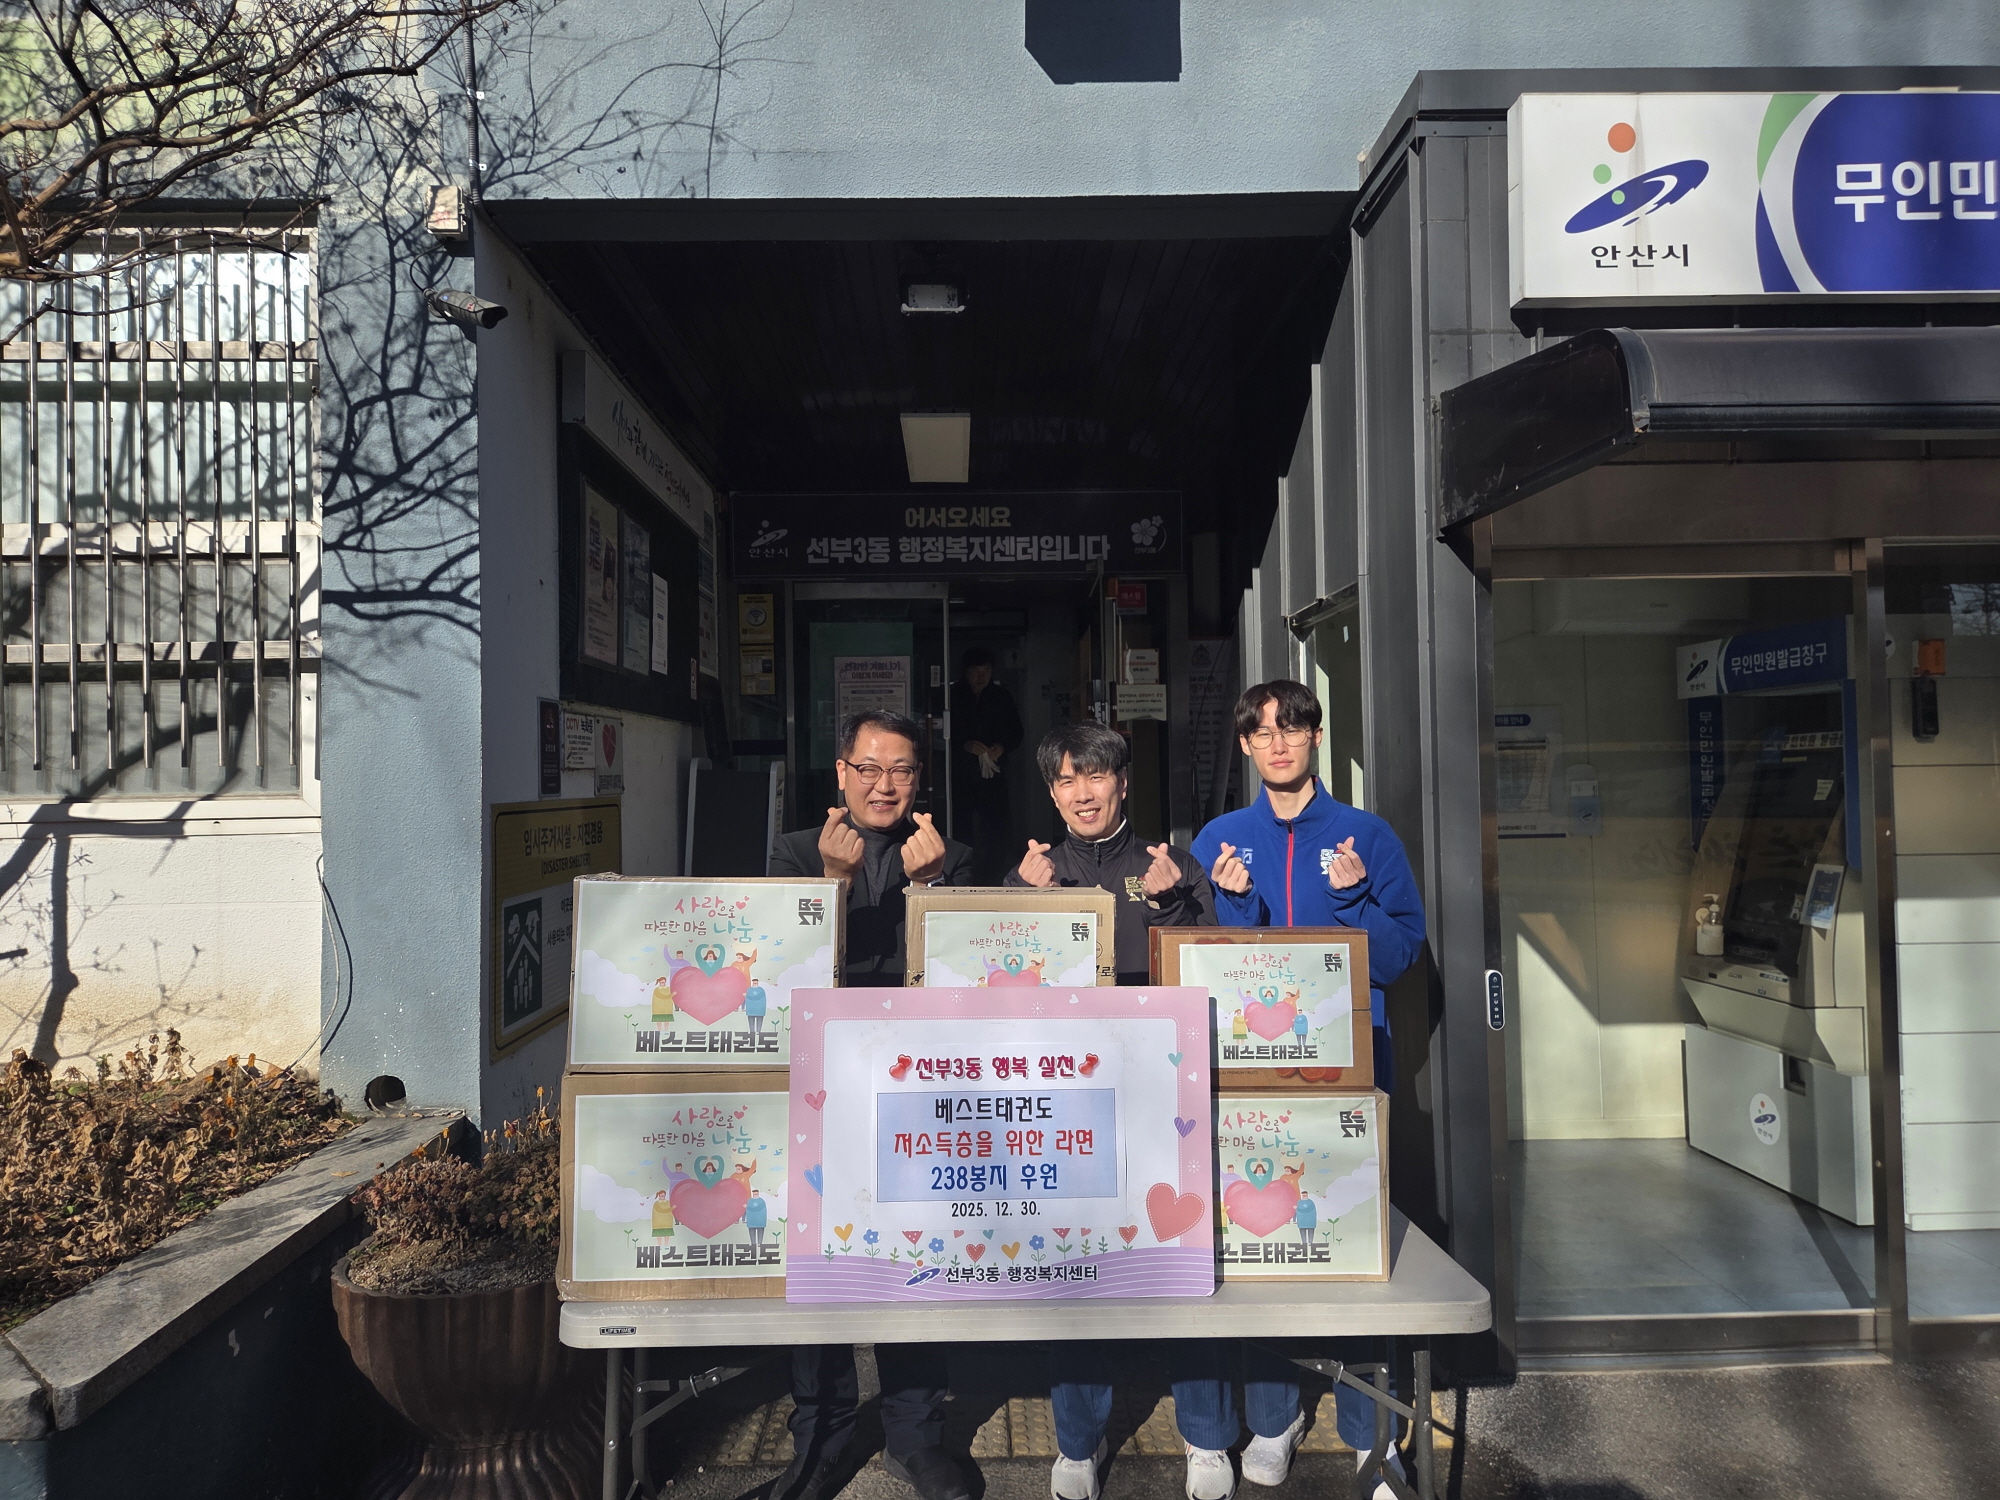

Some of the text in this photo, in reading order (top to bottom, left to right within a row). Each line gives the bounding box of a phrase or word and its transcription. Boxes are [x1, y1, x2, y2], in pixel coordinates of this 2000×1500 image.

[1834, 159, 1999, 223] 무인민
[1590, 243, 1690, 268] 안산시
[904, 506, 1012, 529] 어서오세요
[748, 547, 789, 558] 안산시
[806, 534, 1110, 563] 선부3동 행정복지센터입니다
[1731, 643, 1828, 676] 무인민원발급창구
[566, 716, 580, 731] CCTV
[523, 824, 571, 856] 임시주거시설
[541, 857, 569, 878] (DISASTER
[675, 895, 736, 919] 사랑으로
[644, 916, 754, 943] 따뜻한 마음 나눔
[989, 921, 1030, 937] 사랑으로
[969, 935, 1042, 954] 따뜻한 마음 나눔
[1242, 952, 1283, 969] 사랑으로
[1223, 967, 1297, 985] 따뜻한 마음 나눔
[635, 1030, 779, 1053] 베스트태권도
[1223, 1044, 1319, 1061] 베스트태권도
[915, 1055, 1076, 1081] 선부3동 행복 실천
[671, 1105, 734, 1129] 사랑으로
[935, 1096, 1053, 1124] 베스트태권도
[1223, 1110, 1281, 1133] 사랑으로
[642, 1126, 752, 1154] 따뜻한 마음 나눔
[894, 1129, 1094, 1159] 저소득층을 위한 라면
[1233, 1136, 1256, 1150] 마음
[1261, 1130, 1300, 1157] 나눔
[931, 1163, 1058, 1192] 238봉지 후원
[951, 1201, 1041, 1217] 2025. 12. 30.
[636, 1243, 781, 1269] 베스트태권도
[945, 1265, 1098, 1283] 선부3동 행정복지센터
